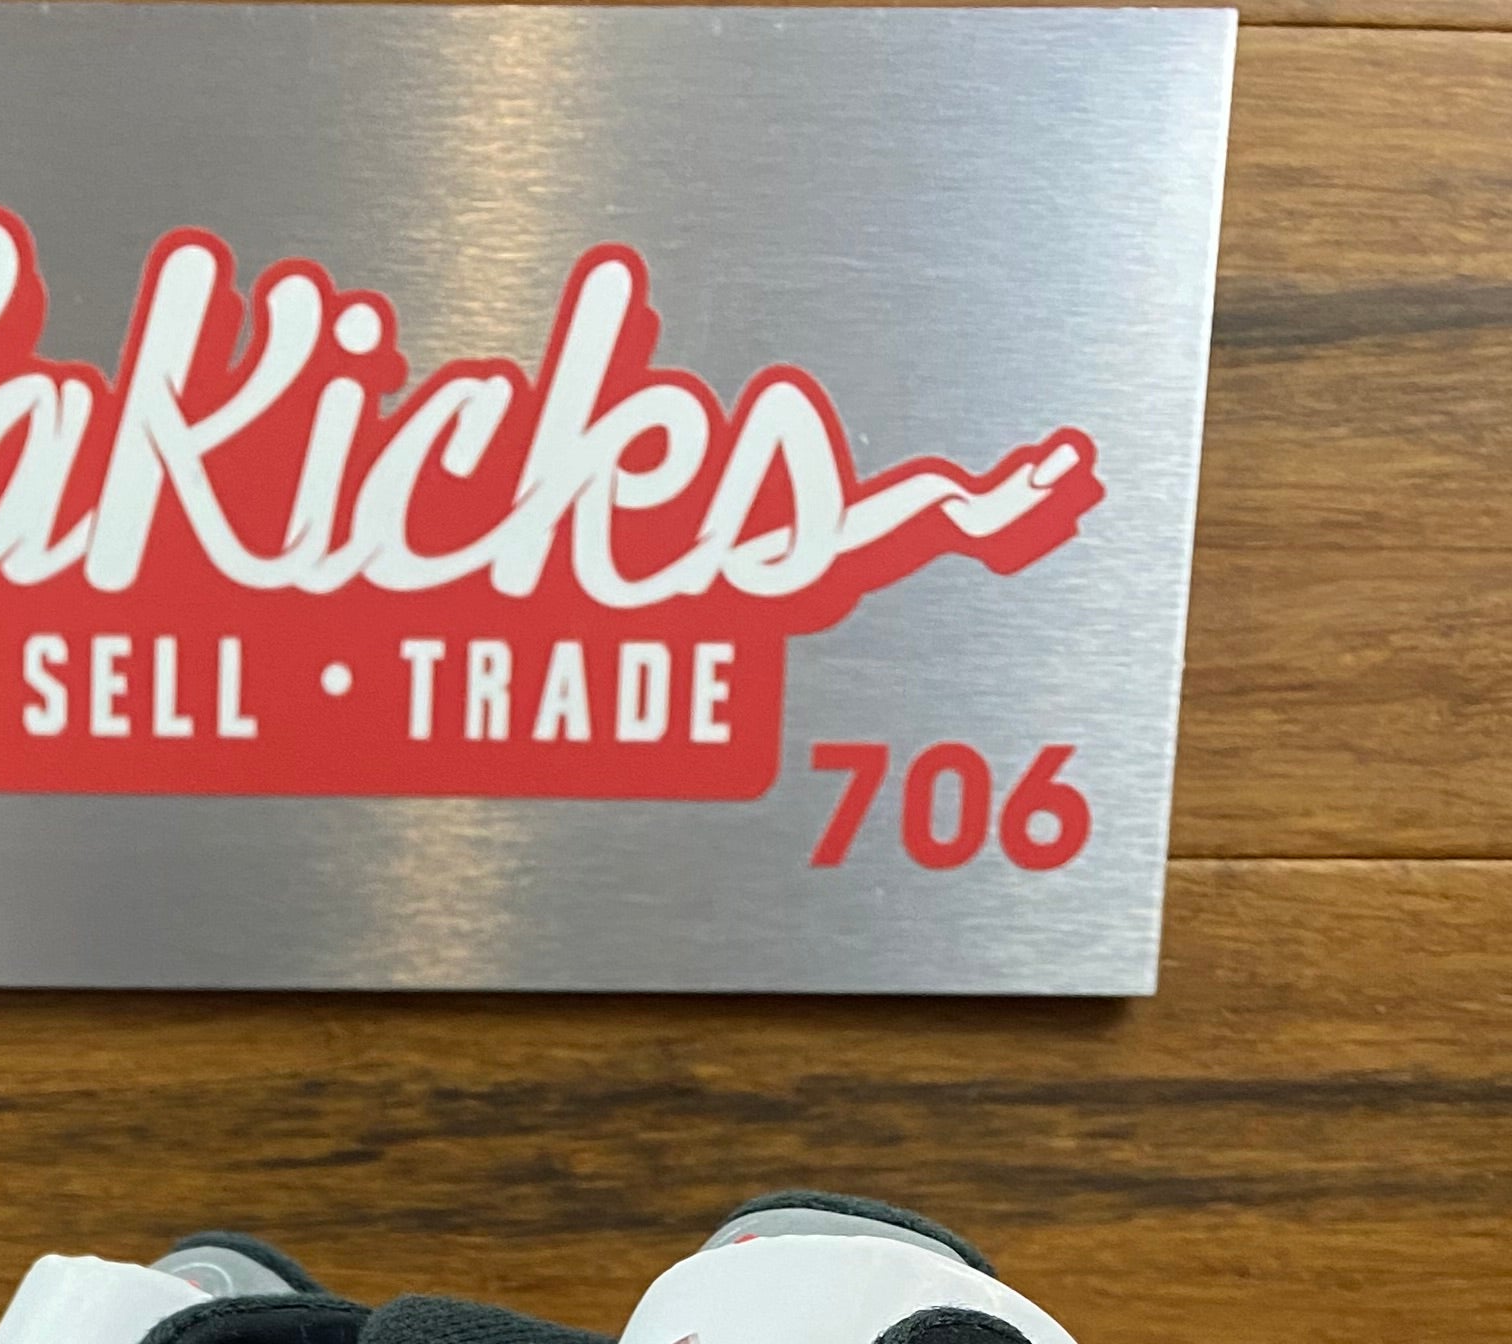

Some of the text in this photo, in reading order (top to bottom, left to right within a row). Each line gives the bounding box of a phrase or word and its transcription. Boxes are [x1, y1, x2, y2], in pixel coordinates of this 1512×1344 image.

[22, 635, 257, 740] SELL
[399, 640, 735, 744] TRADE
[809, 741, 1092, 871] 706
